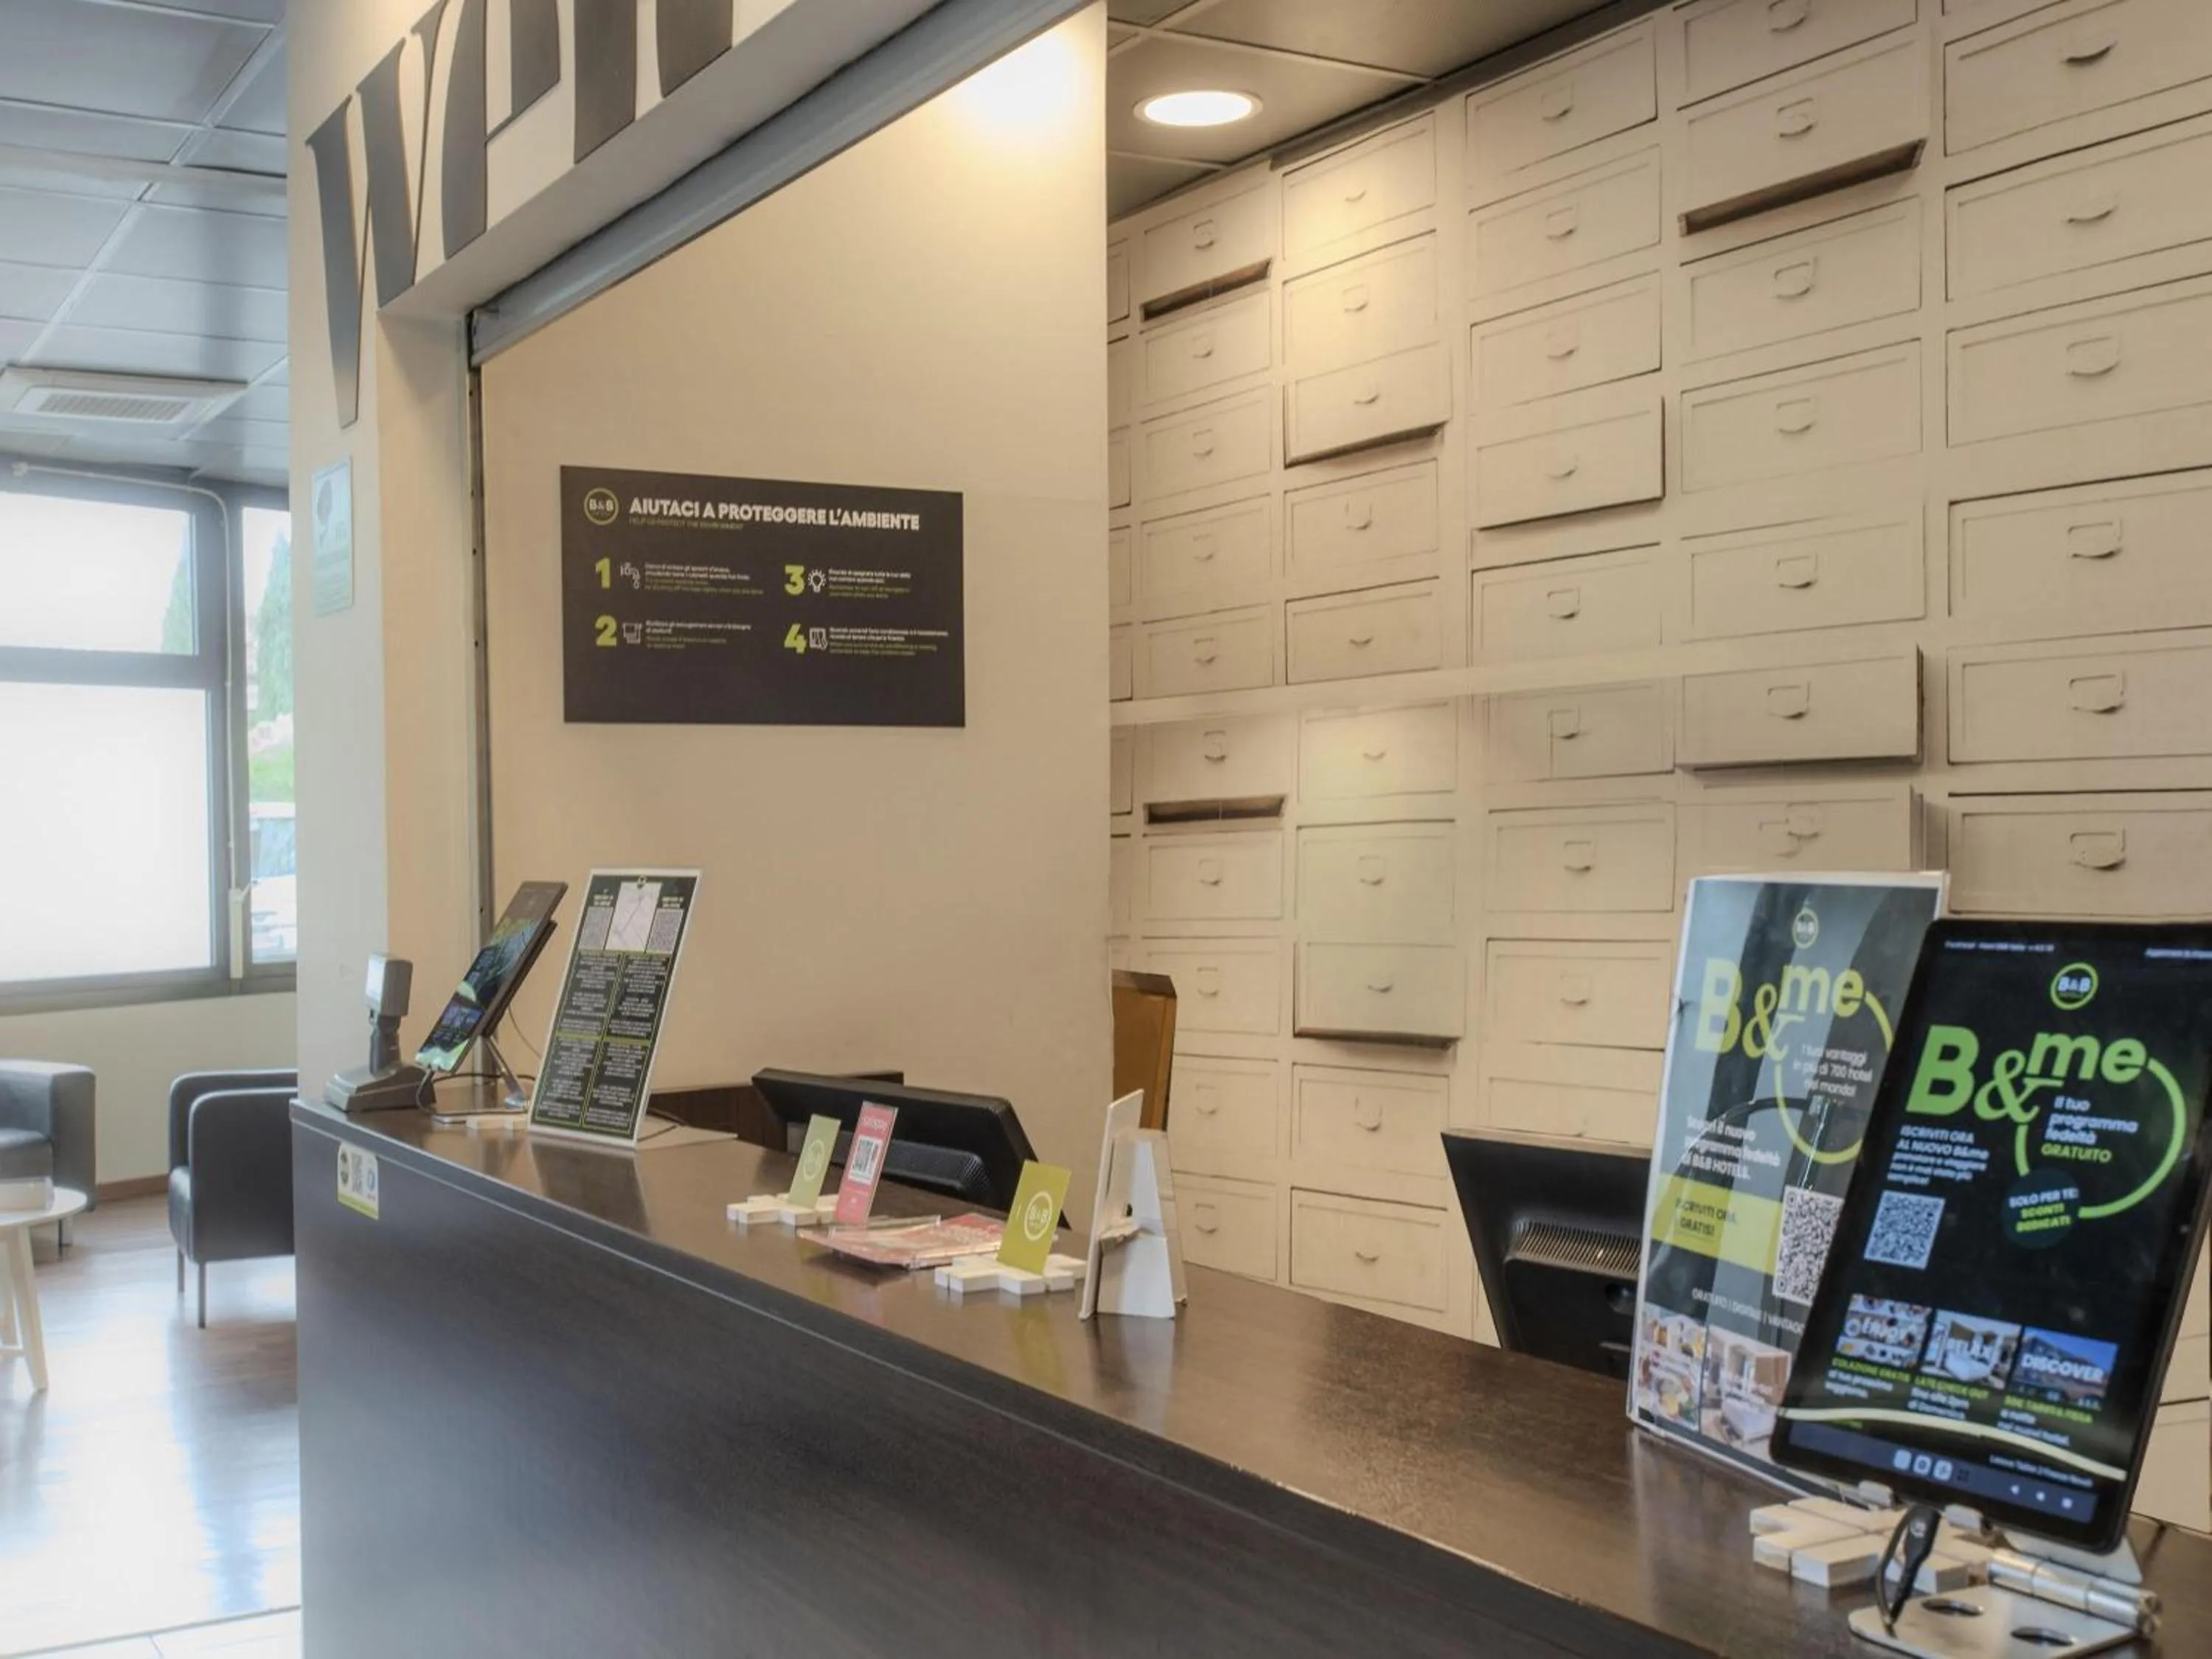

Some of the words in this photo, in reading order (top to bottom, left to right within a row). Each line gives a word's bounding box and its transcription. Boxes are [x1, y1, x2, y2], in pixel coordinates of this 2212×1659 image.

[629, 496, 700, 518] AIUTACI
[702, 502, 717, 519] A
[718, 502, 827, 526] PROTEGGERE
[829, 507, 920, 531] L'AMBIENTE
[595, 557, 611, 589] 1
[784, 564, 805, 596] 3
[595, 615, 618, 647] 2
[785, 624, 807, 654] 4
[2057, 976, 2092, 993] B&B
[1695, 958, 1865, 1061] B&me
[1825, 1049, 1868, 1068] vantaggi
[1830, 1062, 1847, 1079] 700
[1905, 1024, 2147, 1124] B&me
[2065, 1097, 2090, 1112] tuo
[1899, 1124, 1949, 1141] ISCRIVITI
[1950, 1130, 1975, 1144] ORA
[2047, 1113, 2139, 1135] programma
[1896, 1138, 1910, 1150] AL
[1911, 1140, 1952, 1155] NUOVO
[2041, 1143, 2113, 1164] GRATUITO
[1675, 1197, 1715, 1220] ICRIVITI
[2008, 1193, 2039, 1208] SOLO
[2039, 1189, 2061, 1203] PER
[2020, 1203, 2065, 1219] SCONTI
[2015, 1215, 2072, 1233] DEDICATI
[2020, 1353, 2105, 1384] DISCOVER
